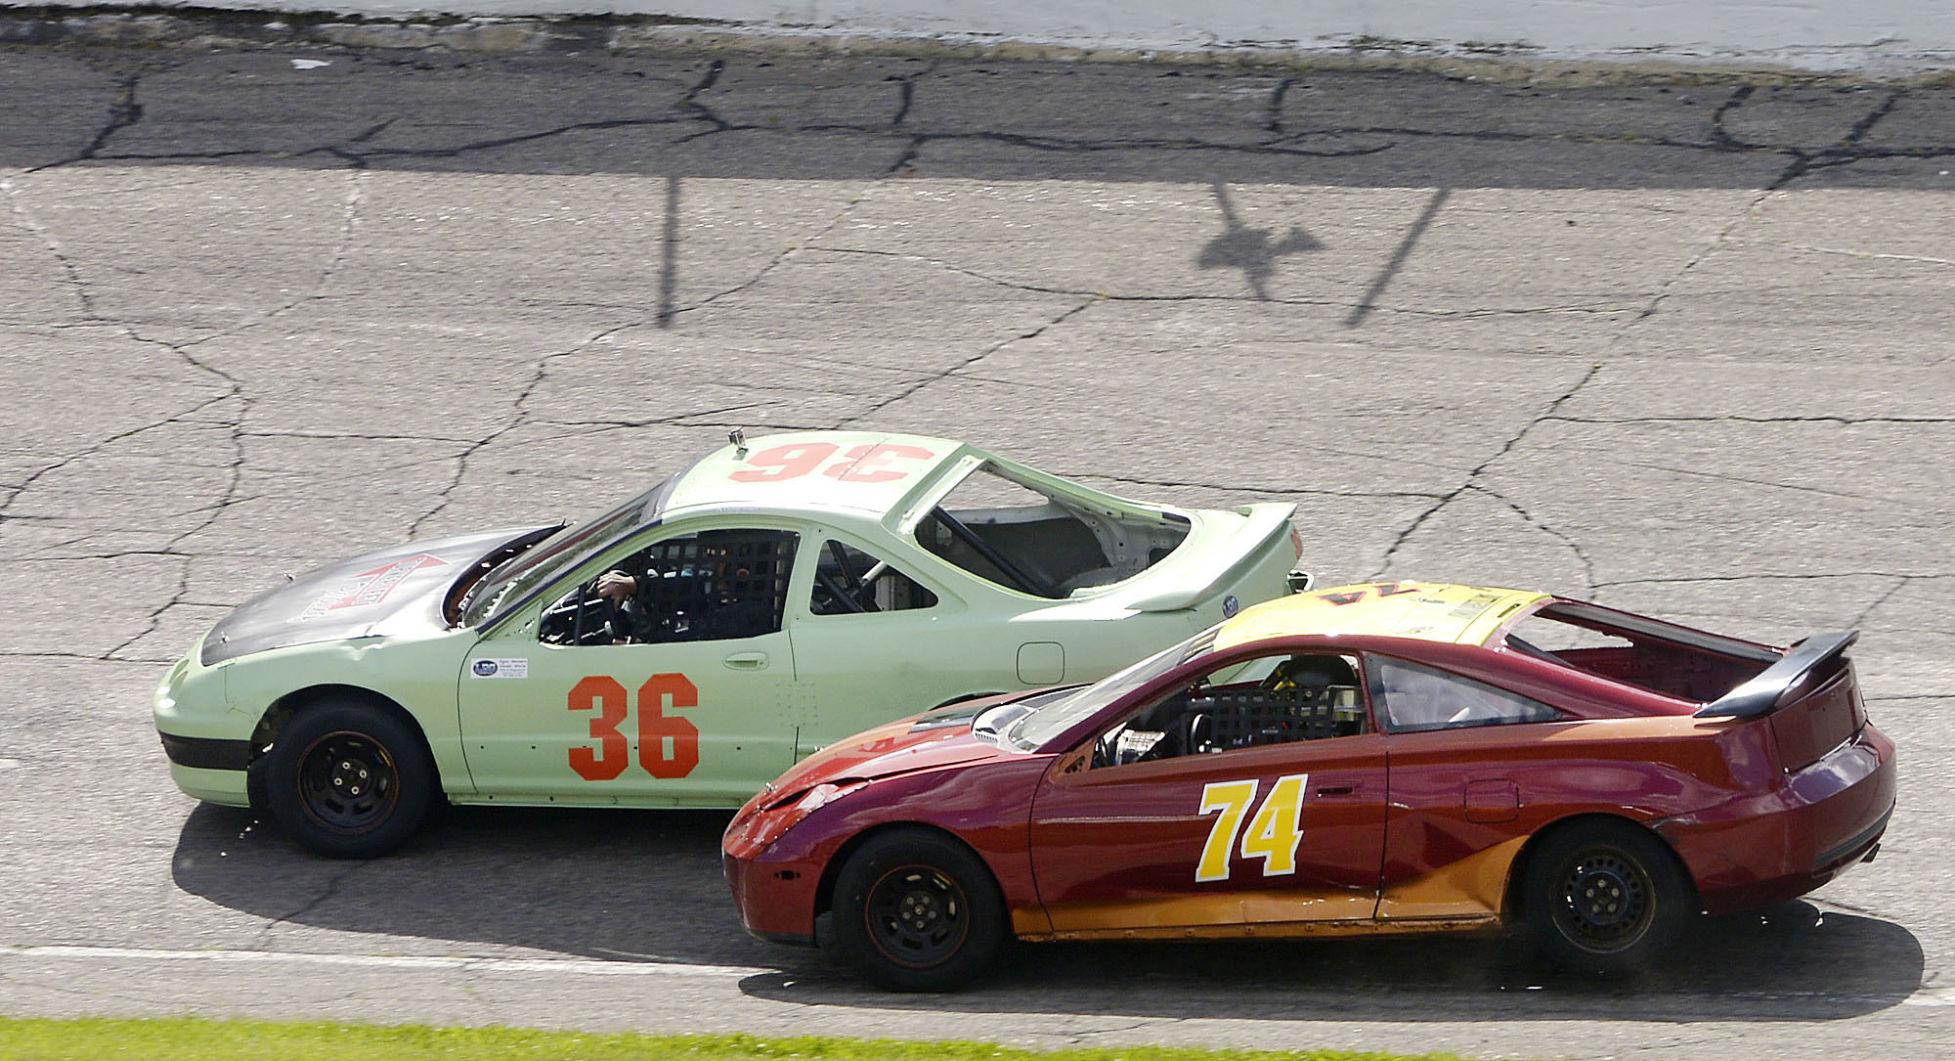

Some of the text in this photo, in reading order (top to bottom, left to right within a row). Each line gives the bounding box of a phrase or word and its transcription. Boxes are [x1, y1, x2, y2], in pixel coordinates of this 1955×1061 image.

[728, 442, 935, 483] 36
[568, 673, 699, 781] 36
[1195, 773, 1309, 882] 74
